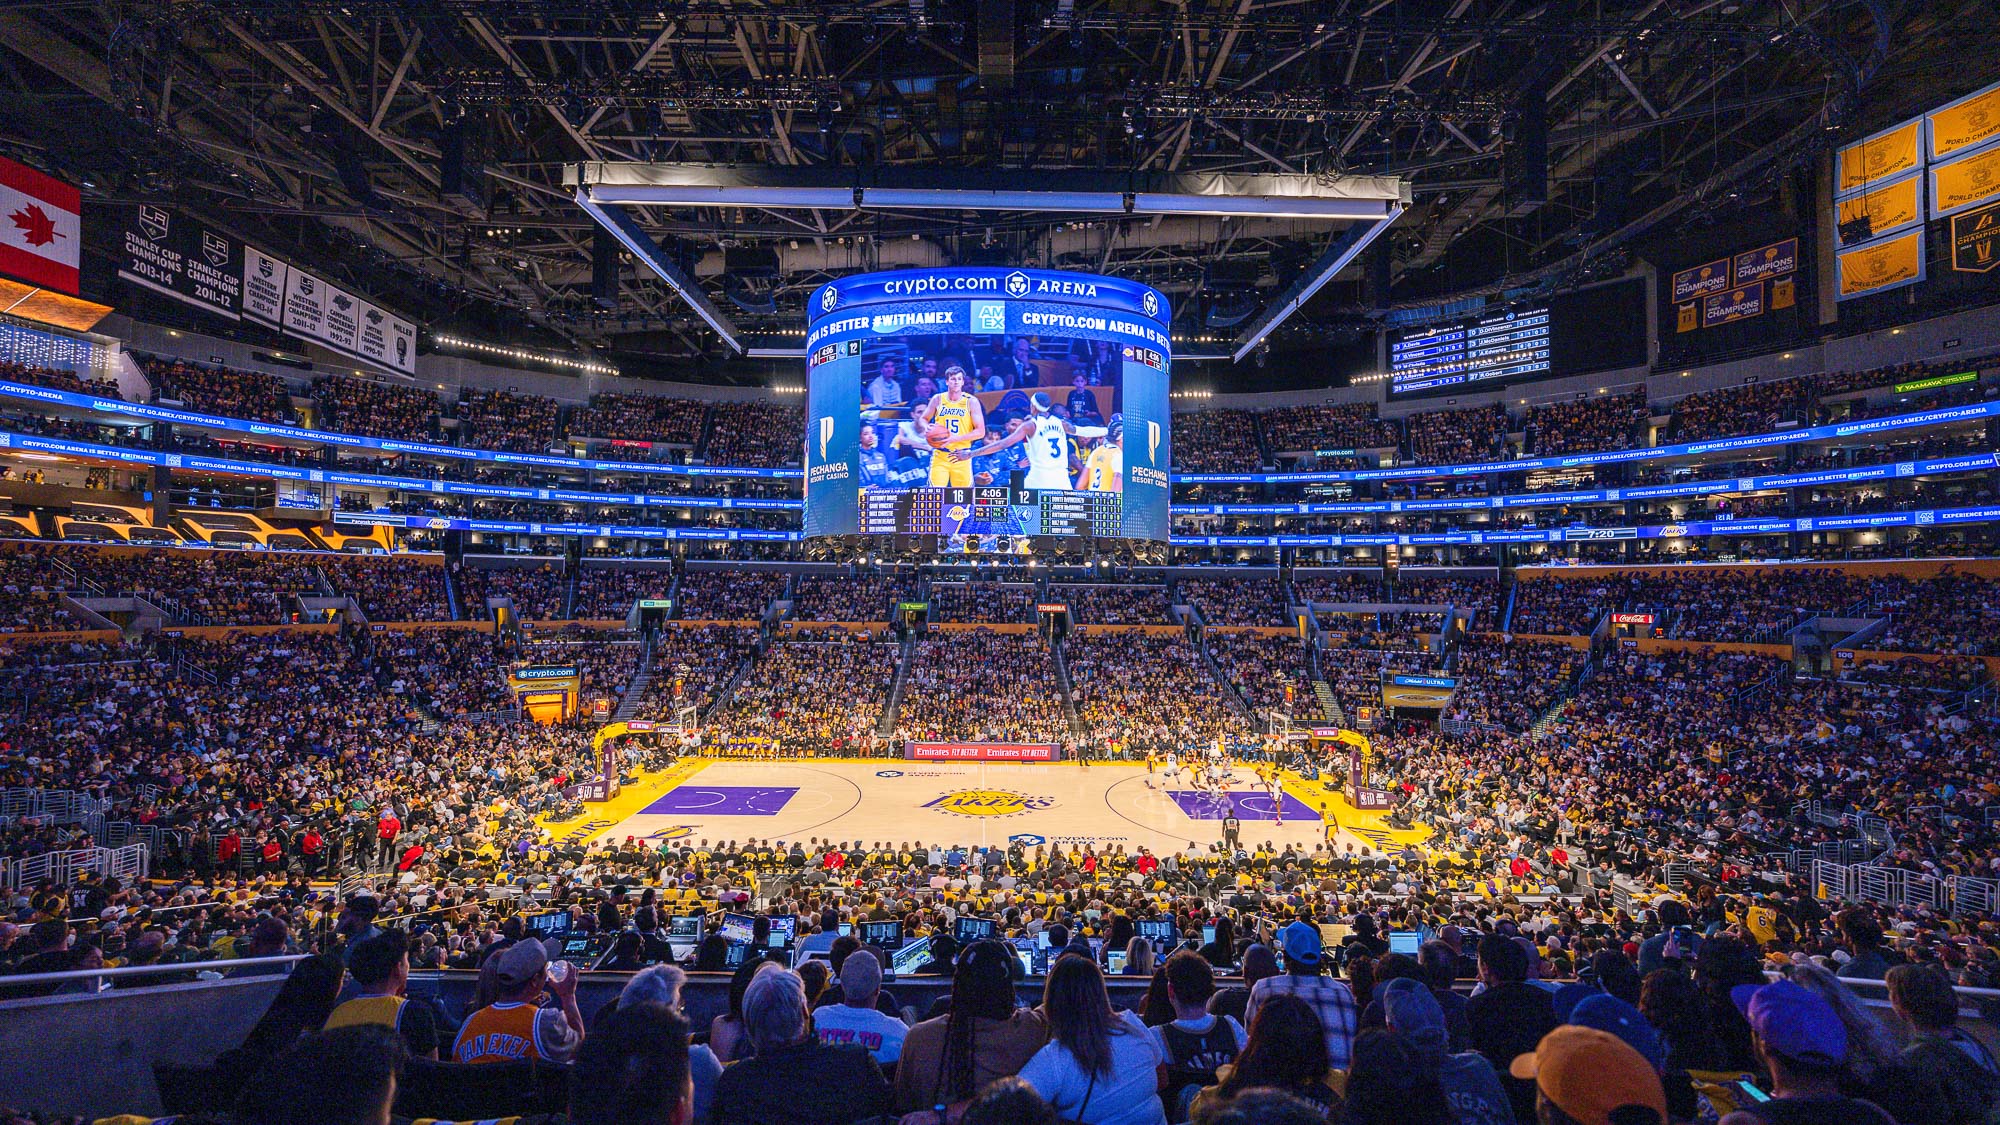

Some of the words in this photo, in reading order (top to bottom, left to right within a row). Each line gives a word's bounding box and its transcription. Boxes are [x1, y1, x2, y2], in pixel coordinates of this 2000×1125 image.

[1945, 137, 1970, 145] WORLD
[1870, 156, 1908, 178] CHAMPIONS
[1948, 193, 1973, 201] WORLD
[1869, 210, 1907, 231] CHAMPIONS
[126, 231, 160, 254] STANLEY
[162, 249, 181, 261] CUP
[125, 242, 182, 273] CHAMPIONS
[132, 259, 173, 285] 2013-14
[188, 259, 222, 279] STANLEY
[223, 275, 239, 286] CUP
[1737, 257, 1793, 278] CHAMPIONS
[187, 269, 239, 296] CHAMPIONS
[252, 275, 277, 291] WESTERN
[1872, 266, 1908, 286] CHAMPIONS
[247, 281, 280, 300] CONFERENCE
[884, 276, 997, 294] crypto.com
[1037, 280, 1097, 297] ARENA
[1676, 276, 1726, 295] CHAMPIONS
[195, 285, 231, 308] 2011-12
[249, 290, 278, 307] CHAMPIONS
[293, 293, 319, 309] WESTERN
[288, 299, 322, 317] CONFERENCE
[288, 307, 321, 324] CHAMPIONS
[1707, 300, 1759, 319] CHAMPIONS
[293, 317, 316, 331] 2011-12
[327, 315, 356, 331] CONFERENCE
[329, 309, 353, 324] CAMPBELL
[820, 325, 828, 337] IS
[830, 317, 869, 335] BETTER
[872, 311, 953, 328] #WITHAMEX
[328, 322, 354, 337] CHAMPIONS
[393, 323, 413, 337] MILLER
[1022, 312, 1106, 330] CRYPTO.COM
[1109, 320, 1145, 338] ARENA
[1147, 329, 1155, 341] IS
[330, 331, 352, 345] 1992-93
[361, 336, 386, 350] CHAMPIONS
[850, 342, 858, 354] 12
[94, 401, 117, 409] LEARN
[118, 404, 137, 412] MORE
[147, 410, 226, 426] GO.AMEX/CRYPTO-ARENA
[939, 406, 966, 417] LAKERS
[945, 419, 959, 434] 15
[1837, 425, 1859, 433] LEARN
[1860, 422, 1880, 430] MORE
[1891, 407, 1987, 426] GO.AMEX/CRYPTO-ARENA
[250, 424, 270, 432] LEARN
[295, 430, 360, 444] GO.AMEX/CRYPTO-ARENA
[1733, 432, 1809, 446] GO.AMEX/CRYPTO-ARENA
[22, 440, 66, 450] CRYPTO.COM
[121, 451, 156, 461] #WITHAMEX
[1048, 437, 1060, 459] 3
[191, 461, 226, 469] CRYPTO.COM
[811, 462, 848, 477] PECHANGA
[1926, 461, 1970, 471] CRYPTO.COM
[810, 475, 824, 483] RESORT
[827, 472, 848, 480] CASINO
[1132, 465, 1167, 482] PECHANGA
[1132, 476, 1153, 484] RESORT
[1763, 478, 1798, 486] CRYPTO.COM
[1825, 473, 1847, 481] BETTER
[1848, 470, 1885, 479] #WITHAMEX
[953, 489, 964, 503] 16
[981, 489, 1002, 497] 4:06
[1019, 491, 1030, 504] 12
[426, 519, 451, 527] LAKERS
[1871, 515, 1907, 523] #WITHAMEX
[1942, 511, 1982, 519] EXPERIENCE
[1587, 530, 1614, 539] 7:20
[1659, 525, 1688, 536] LAKERS
[1037, 604, 1067, 612] TOSHIBA
[1619, 614, 1647, 623] Coca-Cola
[528, 669, 574, 678] crypto.com
[916, 748, 949, 756] Emirates
[951, 748, 961, 756] FLY
[961, 748, 979, 756] BETTER
[987, 748, 1019, 756] Emirates
[1030, 749, 1048, 757] BETTER
[920, 795, 1055, 811] LAKERS
[1758, 915, 1767, 927] 6
[459, 1034, 486, 1063] VAN
[486, 1033, 531, 1060] EXEL
